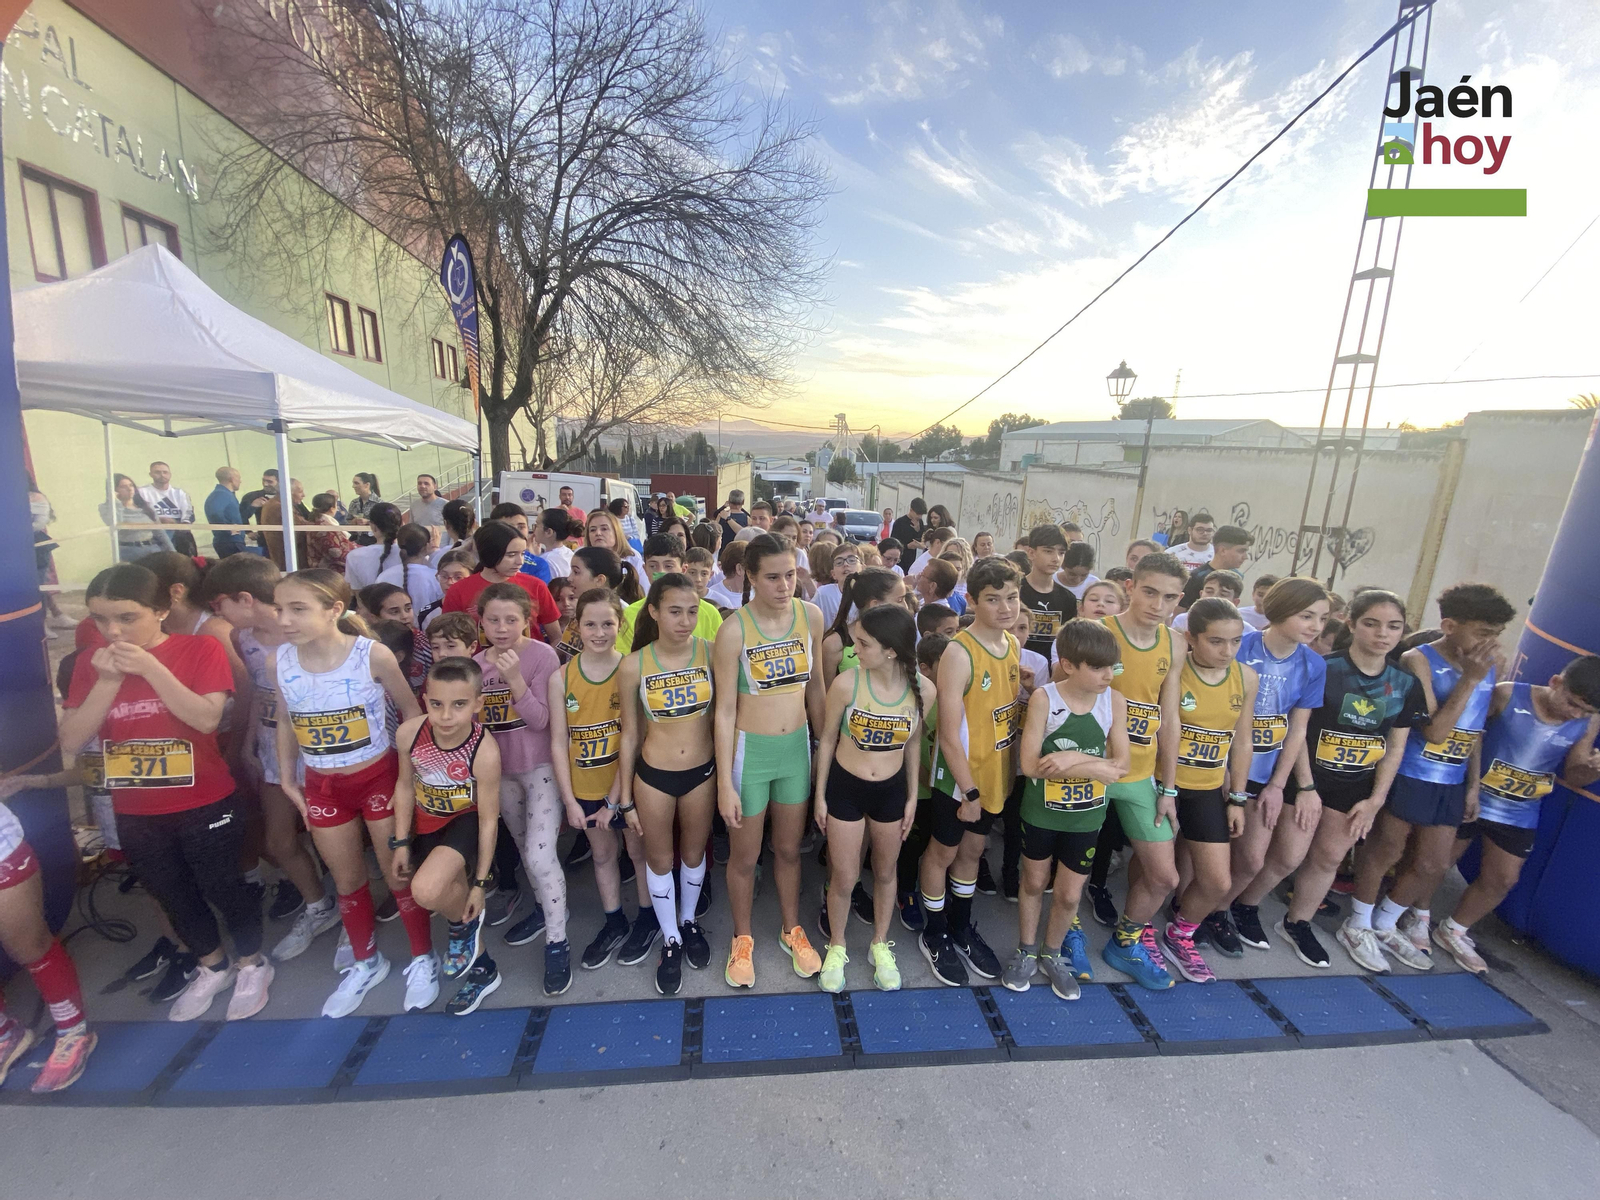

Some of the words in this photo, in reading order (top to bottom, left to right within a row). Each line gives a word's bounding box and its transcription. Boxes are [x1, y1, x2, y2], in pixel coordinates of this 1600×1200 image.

[751, 651, 766, 662] SAN
[764, 657, 796, 680] 350
[649, 679, 665, 690] SAN
[662, 685, 698, 709] 355
[310, 709, 361, 726] SEBASTIÁN
[483, 704, 509, 723] 367
[853, 714, 868, 726] SAN
[868, 718, 908, 730] SEBASTIÁN
[1127, 716, 1149, 735] 39
[308, 725, 351, 746] 352
[861, 728, 895, 745] 368
[1181, 730, 1194, 742] SAN
[1252, 728, 1274, 745] 69
[1325, 735, 1340, 745] SAN
[579, 738, 609, 759] 377
[1186, 742, 1220, 761] 340
[1333, 747, 1370, 764] 357
[1442, 740, 1473, 757] 363
[130, 757, 168, 777] 371
[1061, 784, 1093, 802] 358
[1499, 777, 1537, 797] 370
[424, 794, 455, 812] 331
